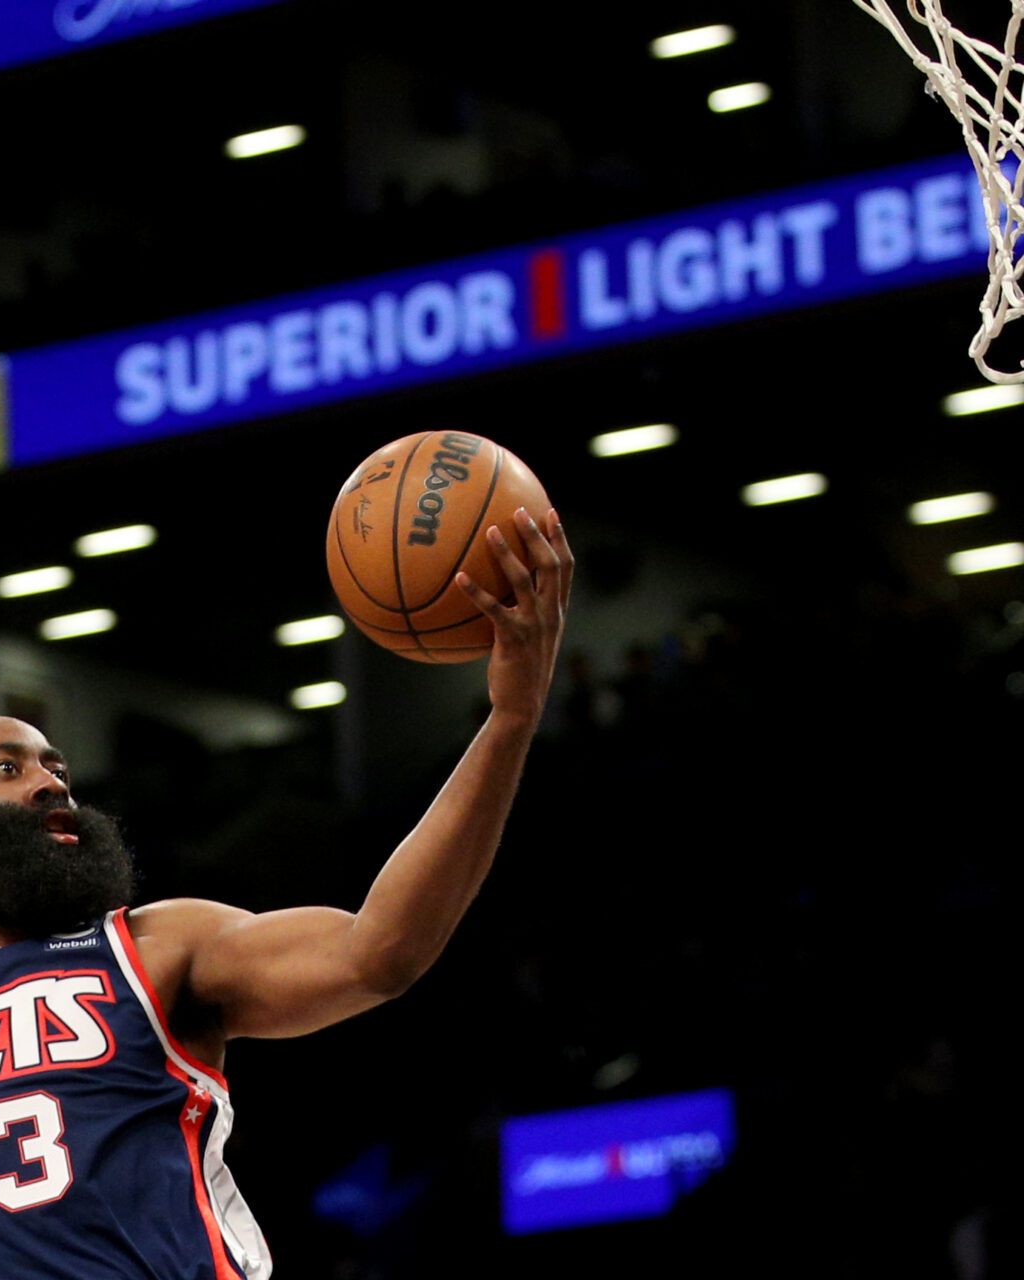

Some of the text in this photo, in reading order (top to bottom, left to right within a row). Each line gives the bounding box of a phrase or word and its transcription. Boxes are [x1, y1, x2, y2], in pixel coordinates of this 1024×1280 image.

[115, 271, 516, 426] SUPERIOR
[578, 202, 838, 330] LIGHT
[407, 432, 484, 546] Wilson
[49, 938, 96, 949] Webull
